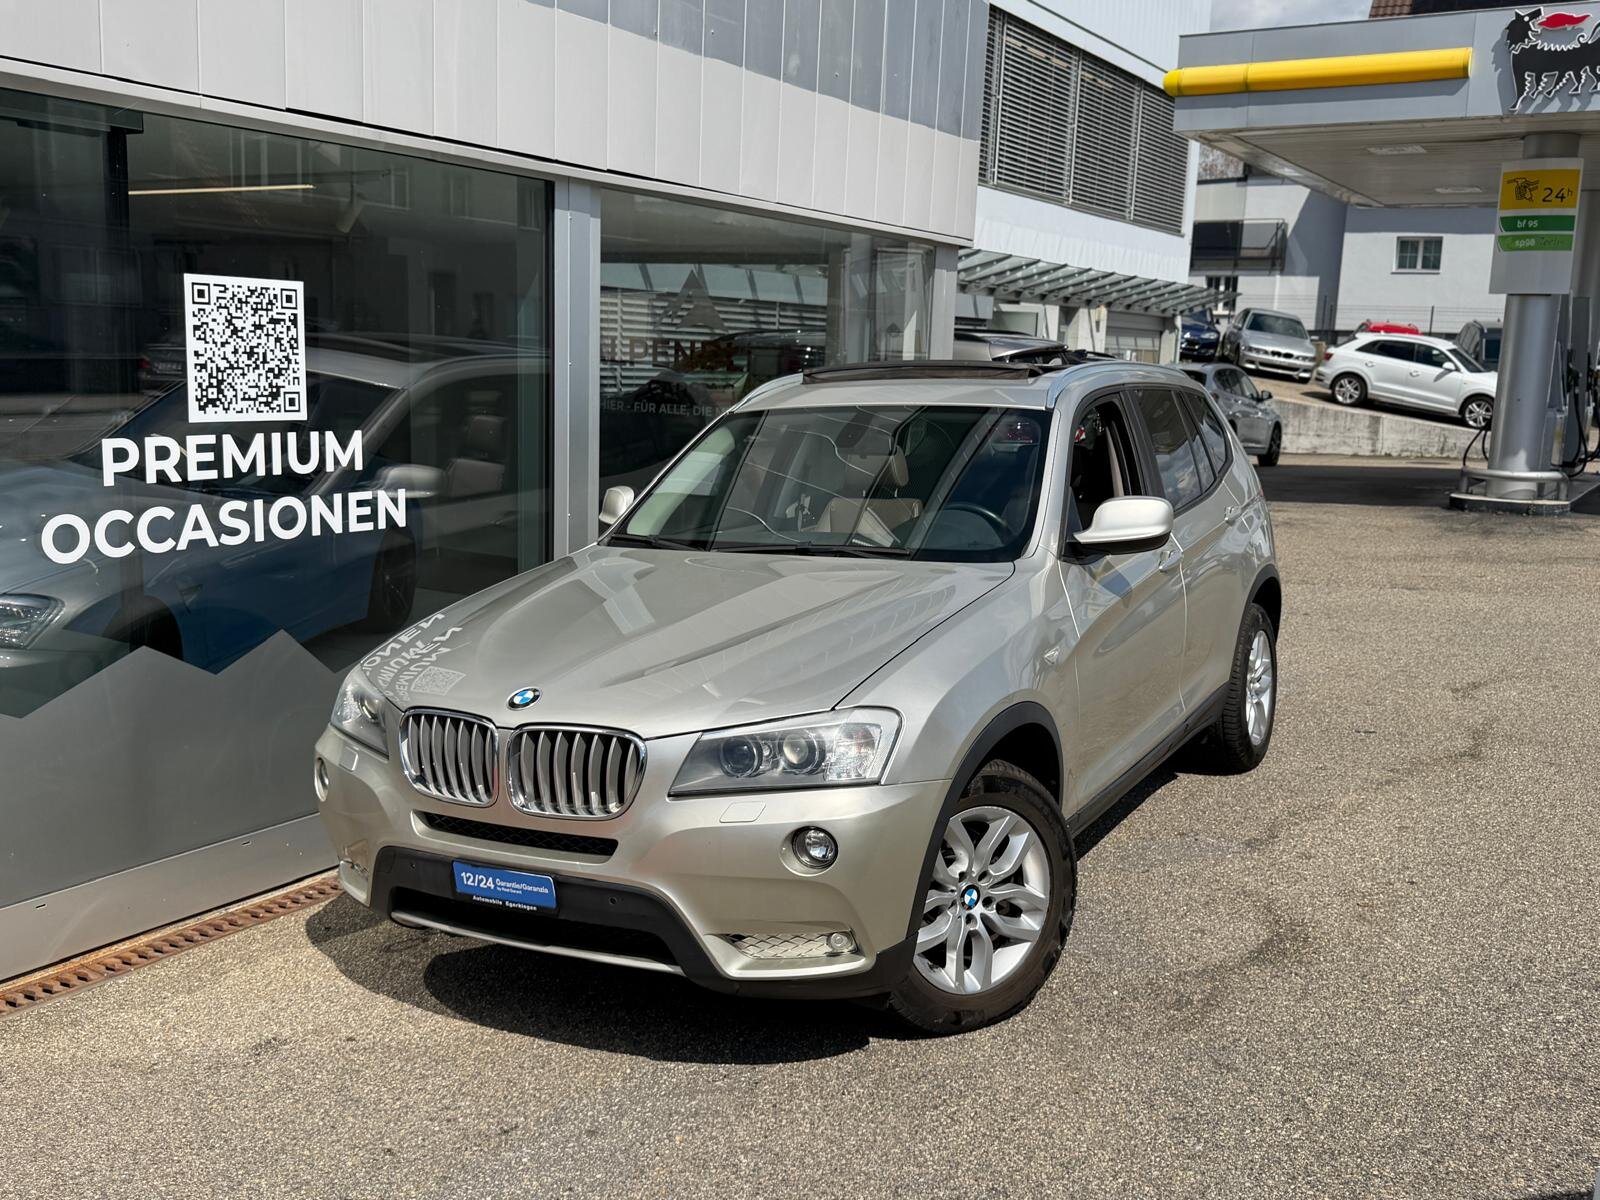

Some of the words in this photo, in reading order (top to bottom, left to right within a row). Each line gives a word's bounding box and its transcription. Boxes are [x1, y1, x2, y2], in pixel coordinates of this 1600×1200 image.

[1528, 219, 1539, 228] 95
[634, 399, 656, 414] FÜR
[658, 403, 690, 416] ALLE,
[692, 406, 712, 416] DIE
[102, 430, 364, 486] PREMIUM
[40, 488, 408, 564] OCCASIONEN
[460, 871, 494, 890] 12/24
[472, 895, 502, 906] Automobile
